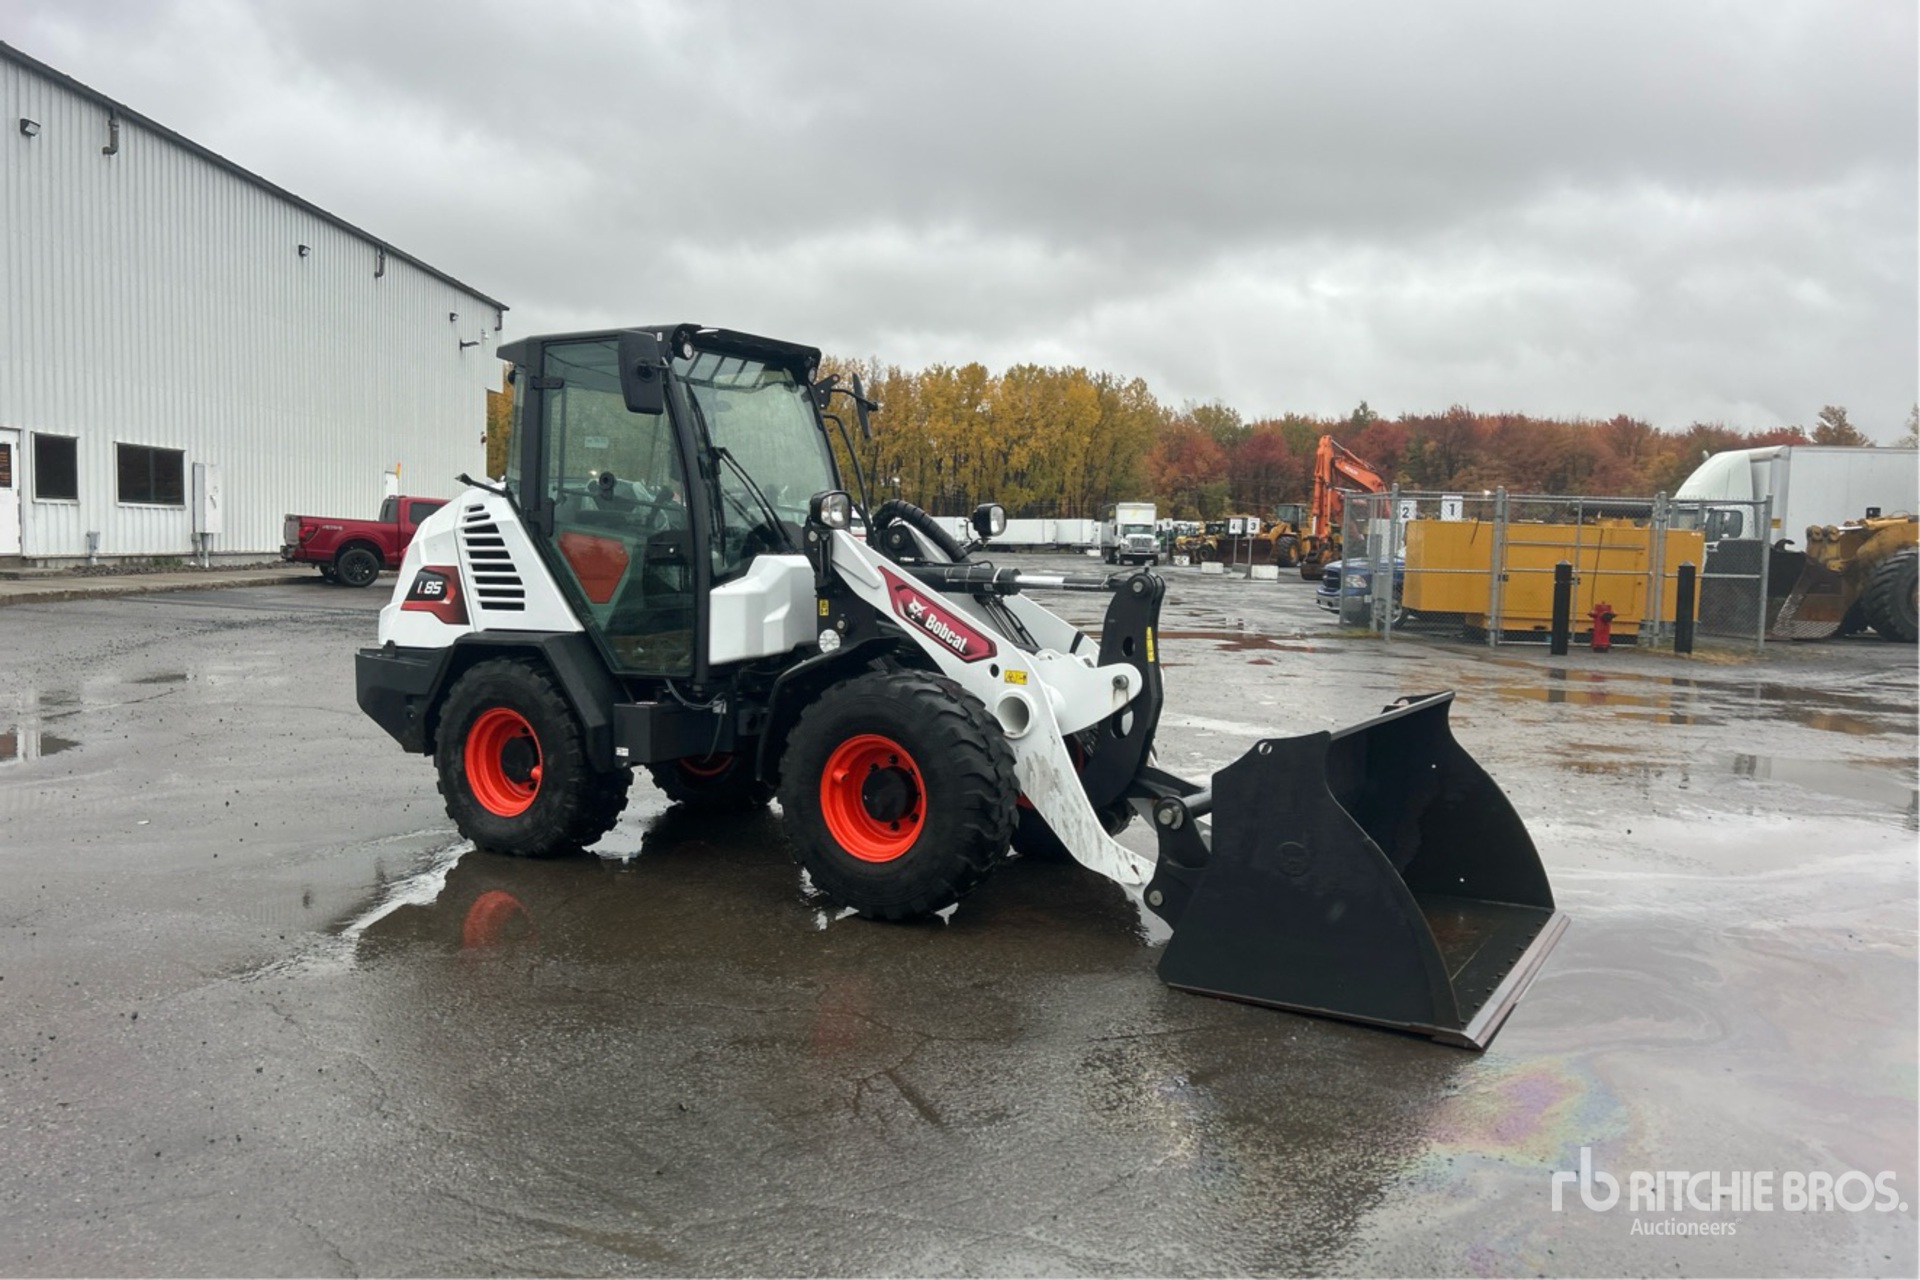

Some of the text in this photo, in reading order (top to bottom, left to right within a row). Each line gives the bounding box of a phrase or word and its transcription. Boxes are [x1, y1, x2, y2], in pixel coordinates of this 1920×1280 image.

[1402, 506, 1409, 518] 2
[1449, 503, 1455, 516] 1
[1250, 522, 1256, 531] 3
[925, 613, 968, 653] Bobcat
